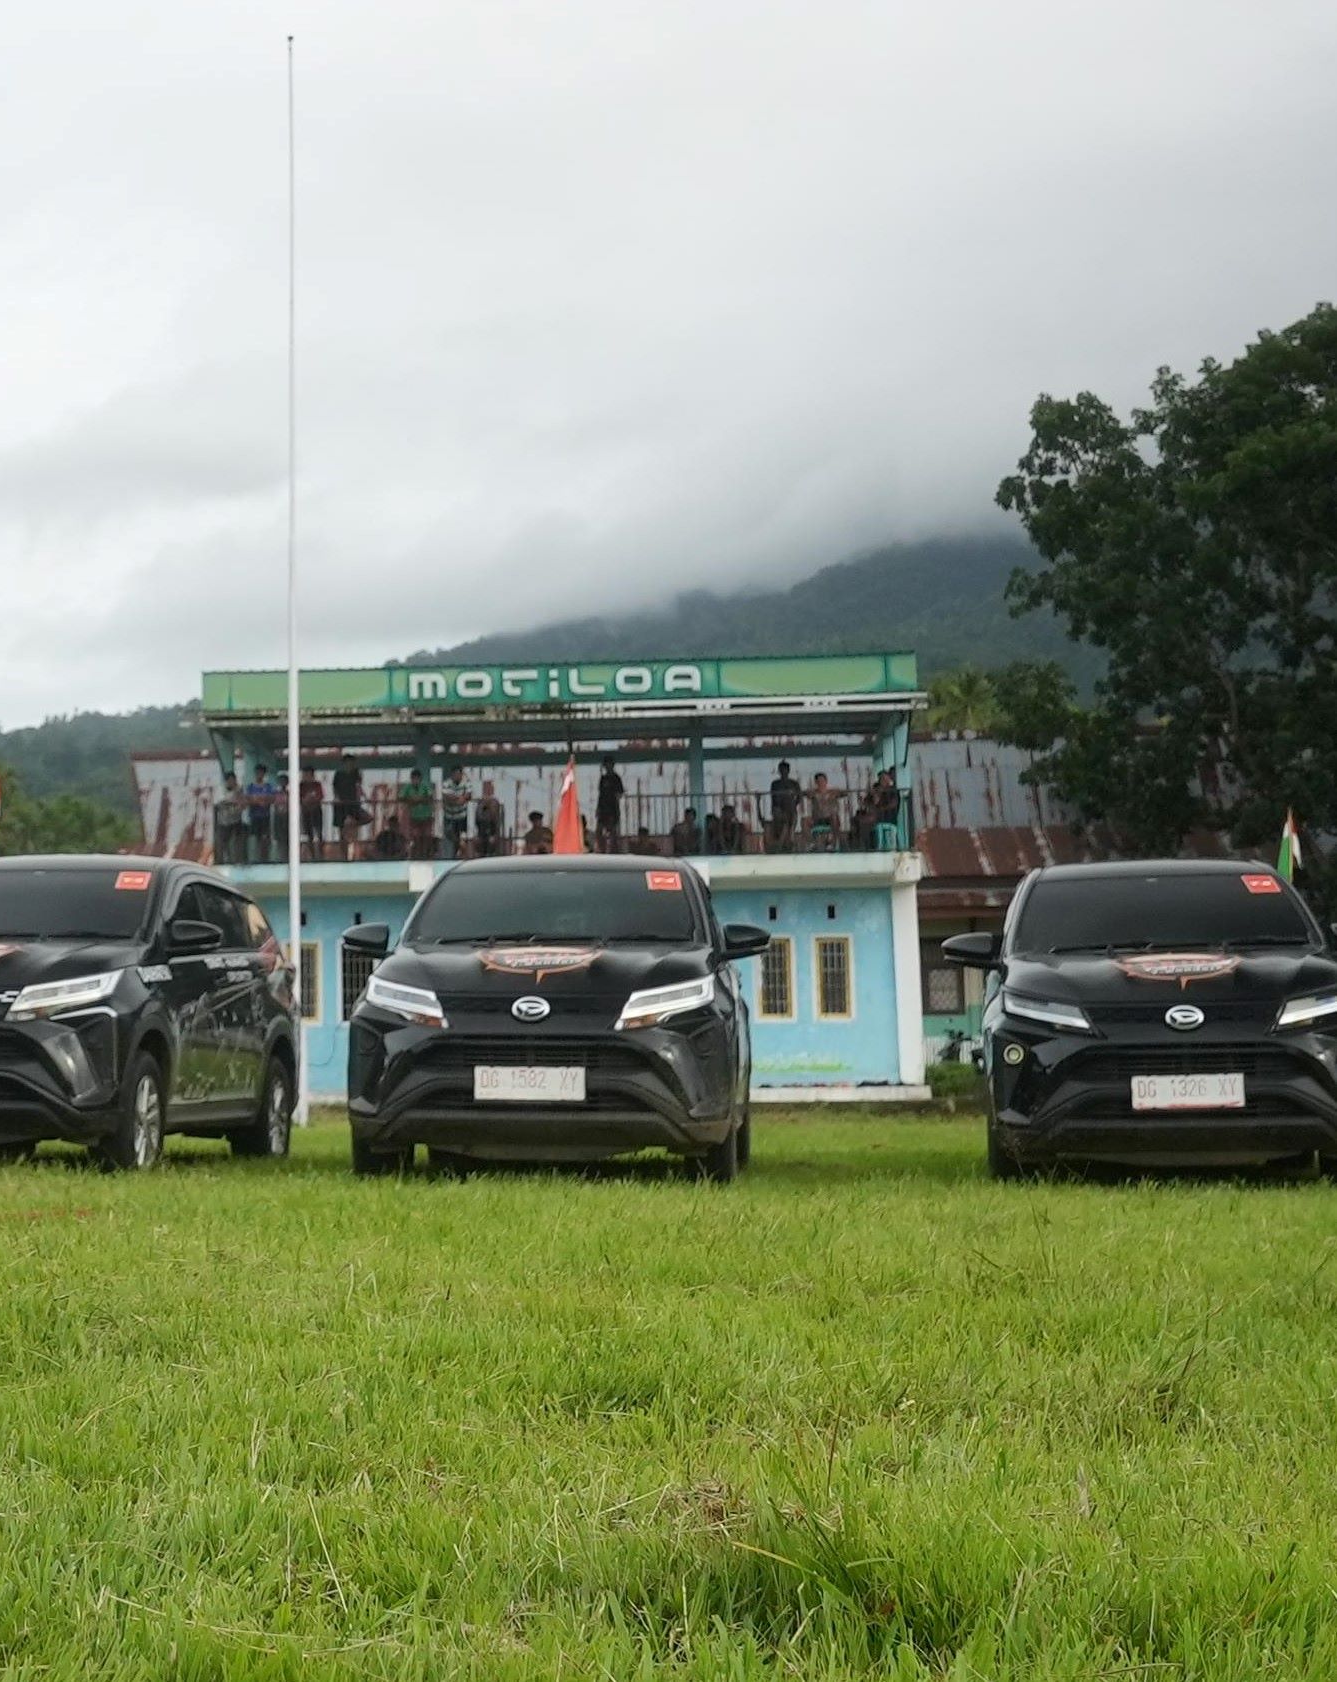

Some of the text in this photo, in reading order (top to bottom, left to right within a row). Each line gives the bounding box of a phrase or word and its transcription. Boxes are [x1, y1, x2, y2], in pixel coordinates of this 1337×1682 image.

[480, 1068, 579, 1092] DG 1582 XY
[1137, 1076, 1237, 1099] DG 1326 XY
